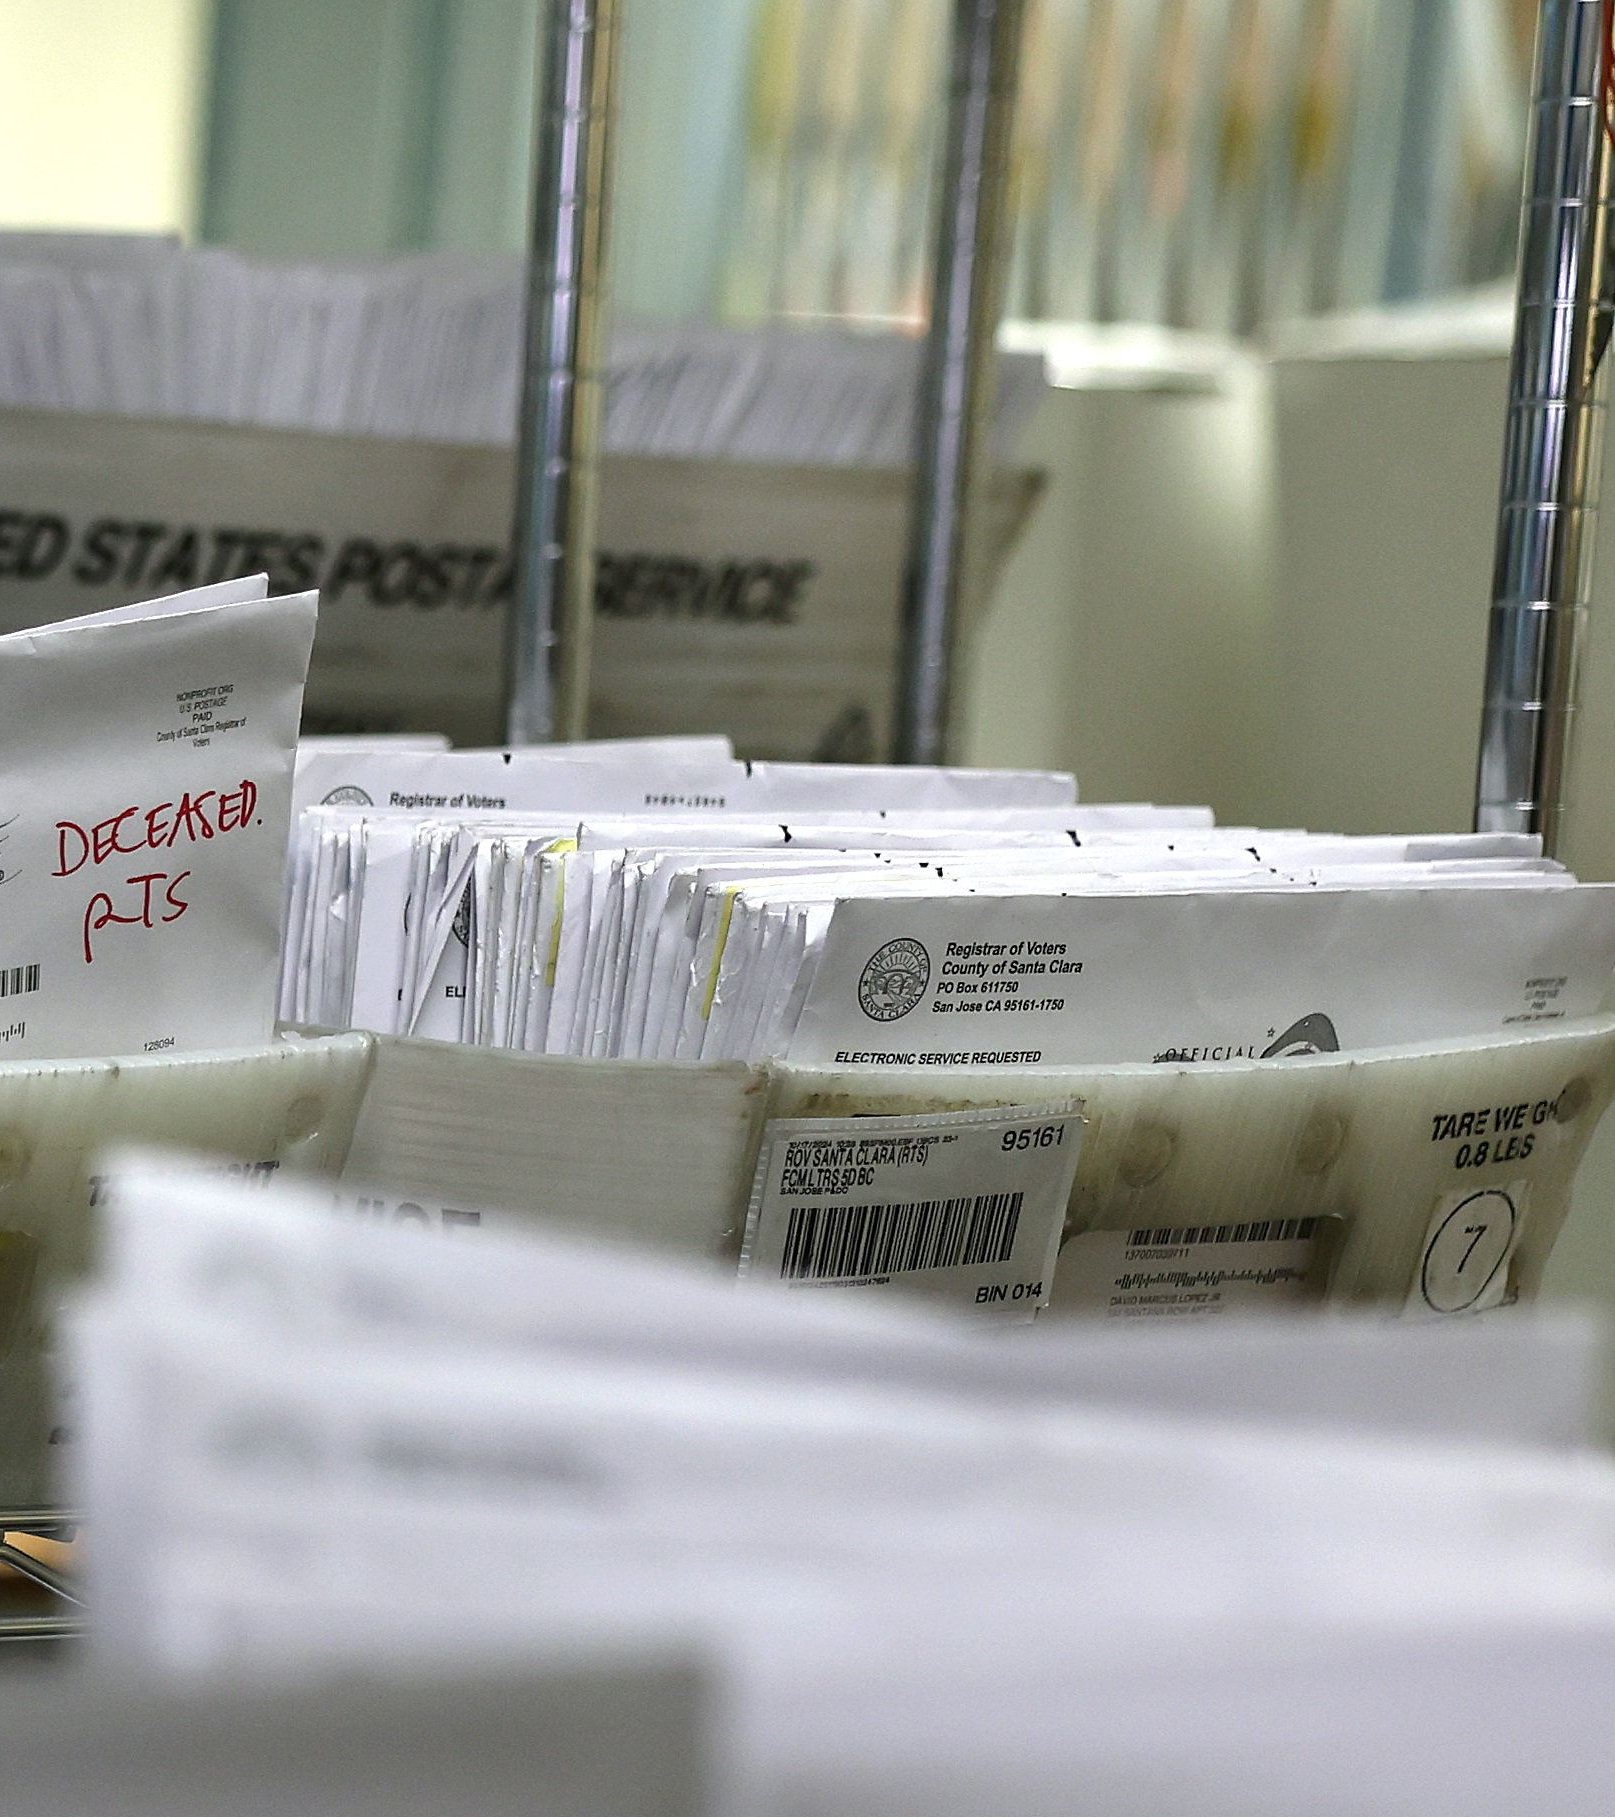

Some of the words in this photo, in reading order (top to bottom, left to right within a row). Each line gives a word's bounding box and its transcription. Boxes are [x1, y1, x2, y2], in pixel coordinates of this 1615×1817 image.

[76, 516, 326, 594] STATES
[328, 536, 516, 610] POST
[194, 696, 228, 711] POSTAGE
[192, 711, 213, 723] PAID
[389, 791, 447, 809] Registrar
[449, 793, 464, 808] of
[83, 871, 191, 963] RTS
[946, 941, 1007, 959] Registrar
[1010, 941, 1024, 956] of
[1026, 941, 1067, 956] Voters
[941, 960, 985, 978] County
[988, 960, 1006, 976] of
[1009, 960, 1046, 976] Santa
[1048, 959, 1083, 975] Clara
[936, 981, 953, 995] PO
[955, 981, 977, 994] Box
[980, 980, 1019, 994] 611750
[932, 1000, 953, 1014] San
[955, 1000, 983, 1013] Jose
[985, 999, 1002, 1012] CA
[1004, 998, 1065, 1012] 95161-1750
[143, 1037, 176, 1052] 128094
[1165, 1044, 1256, 1063] OFFICIAL
[834, 1050, 916, 1065] ELECTRONIC
[918, 1050, 969, 1064] SERVICE
[970, 1050, 1041, 1064] REQUESTED
[1431, 1108, 1491, 1142] TARE
[1494, 1090, 1566, 1133] WEGH
[1000, 1125, 1065, 1152] 95161
[785, 1148, 812, 1167] ROV
[813, 1148, 853, 1167] SANTA
[856, 1147, 896, 1166] CLARA
[897, 1145, 929, 1168] (RTS)
[1454, 1141, 1491, 1169] 0.8
[1491, 1132, 1536, 1163] LBS
[781, 1168, 807, 1187] FCM
[841, 1168, 857, 1186] 5D
[857, 1167, 875, 1186] BC
[780, 1187, 799, 1195] SAN
[799, 1187, 823, 1195] JOSE
[1457, 1224, 1489, 1274] 7
[975, 1284, 1008, 1303] BIN
[1010, 1281, 1043, 1300] 014
